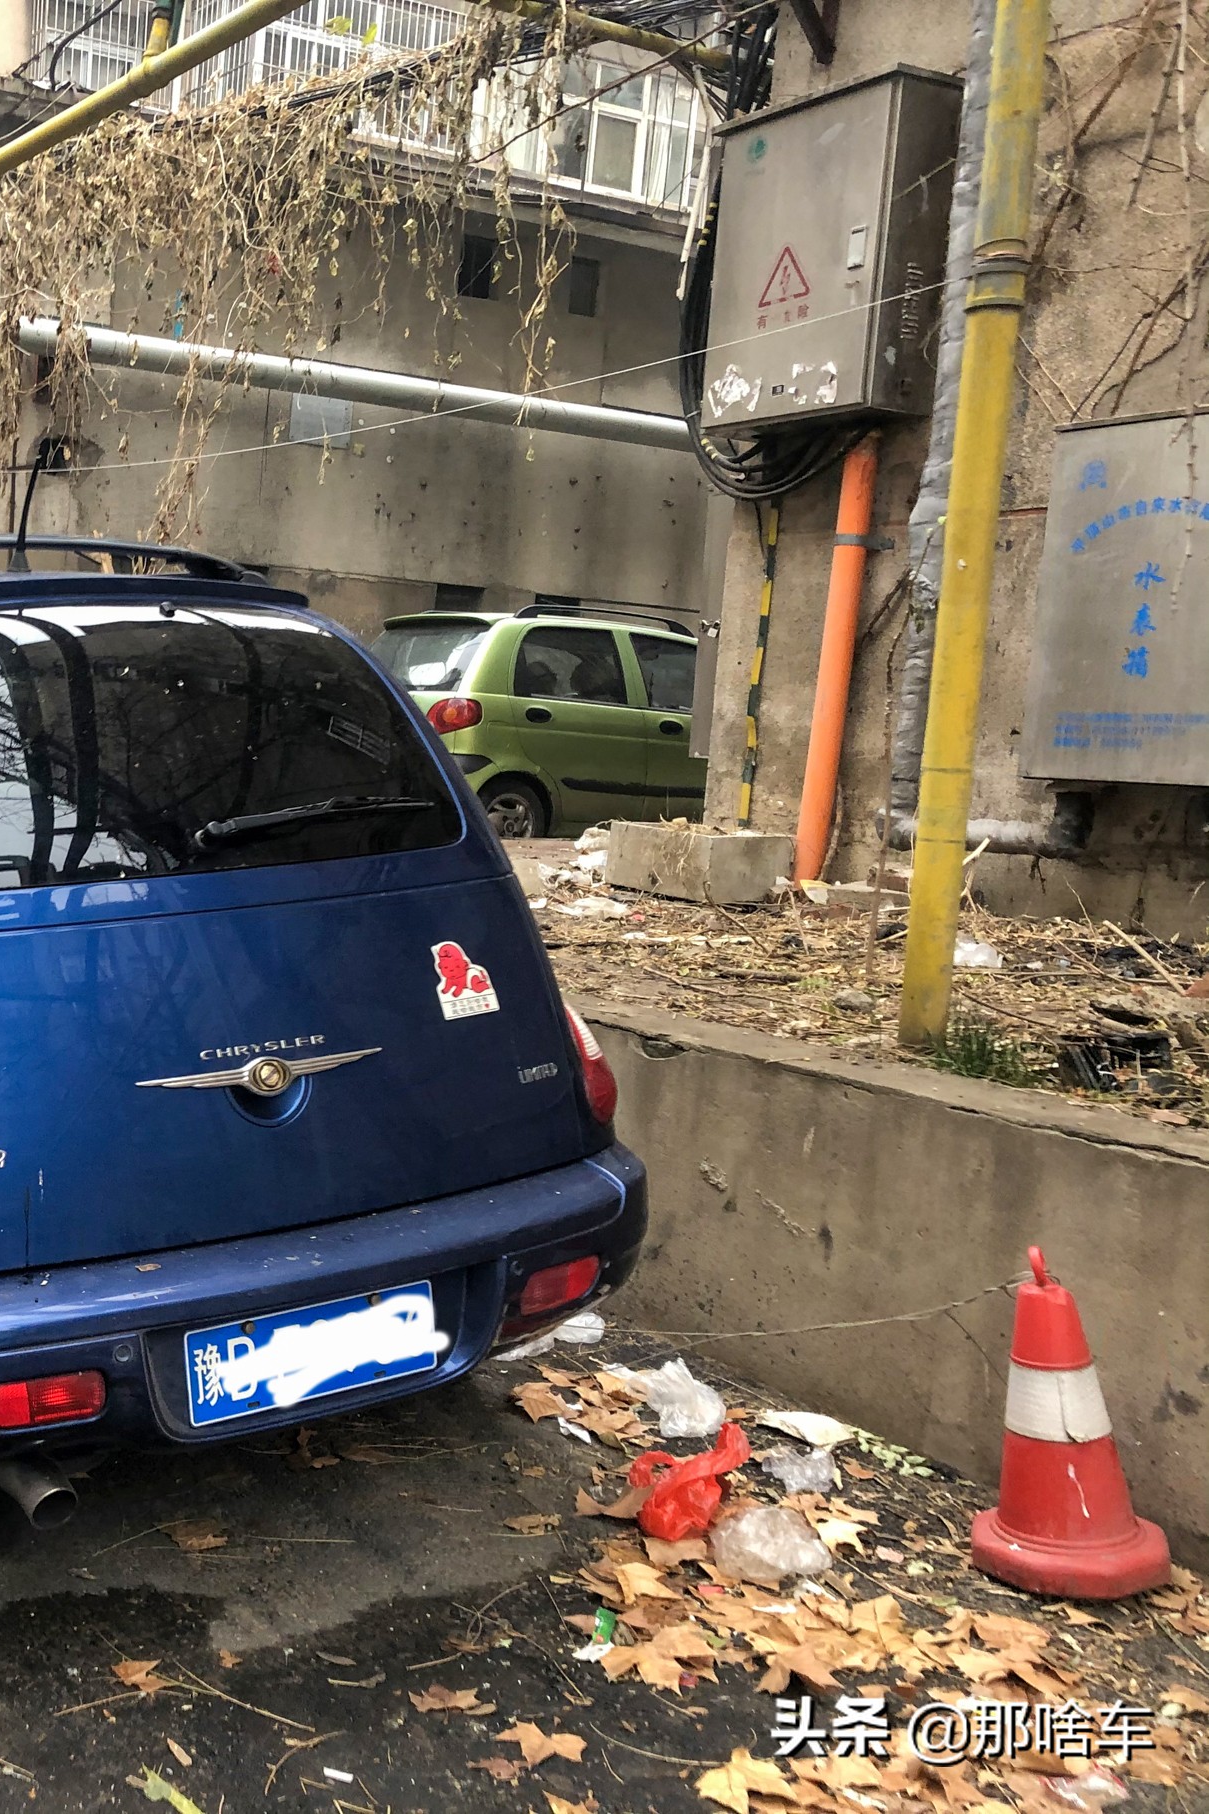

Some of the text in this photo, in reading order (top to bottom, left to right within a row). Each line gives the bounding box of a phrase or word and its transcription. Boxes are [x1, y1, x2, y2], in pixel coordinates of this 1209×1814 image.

[1121, 561, 1167, 678] 水表箱
[199, 1034, 326, 1061] CHRYSLER
